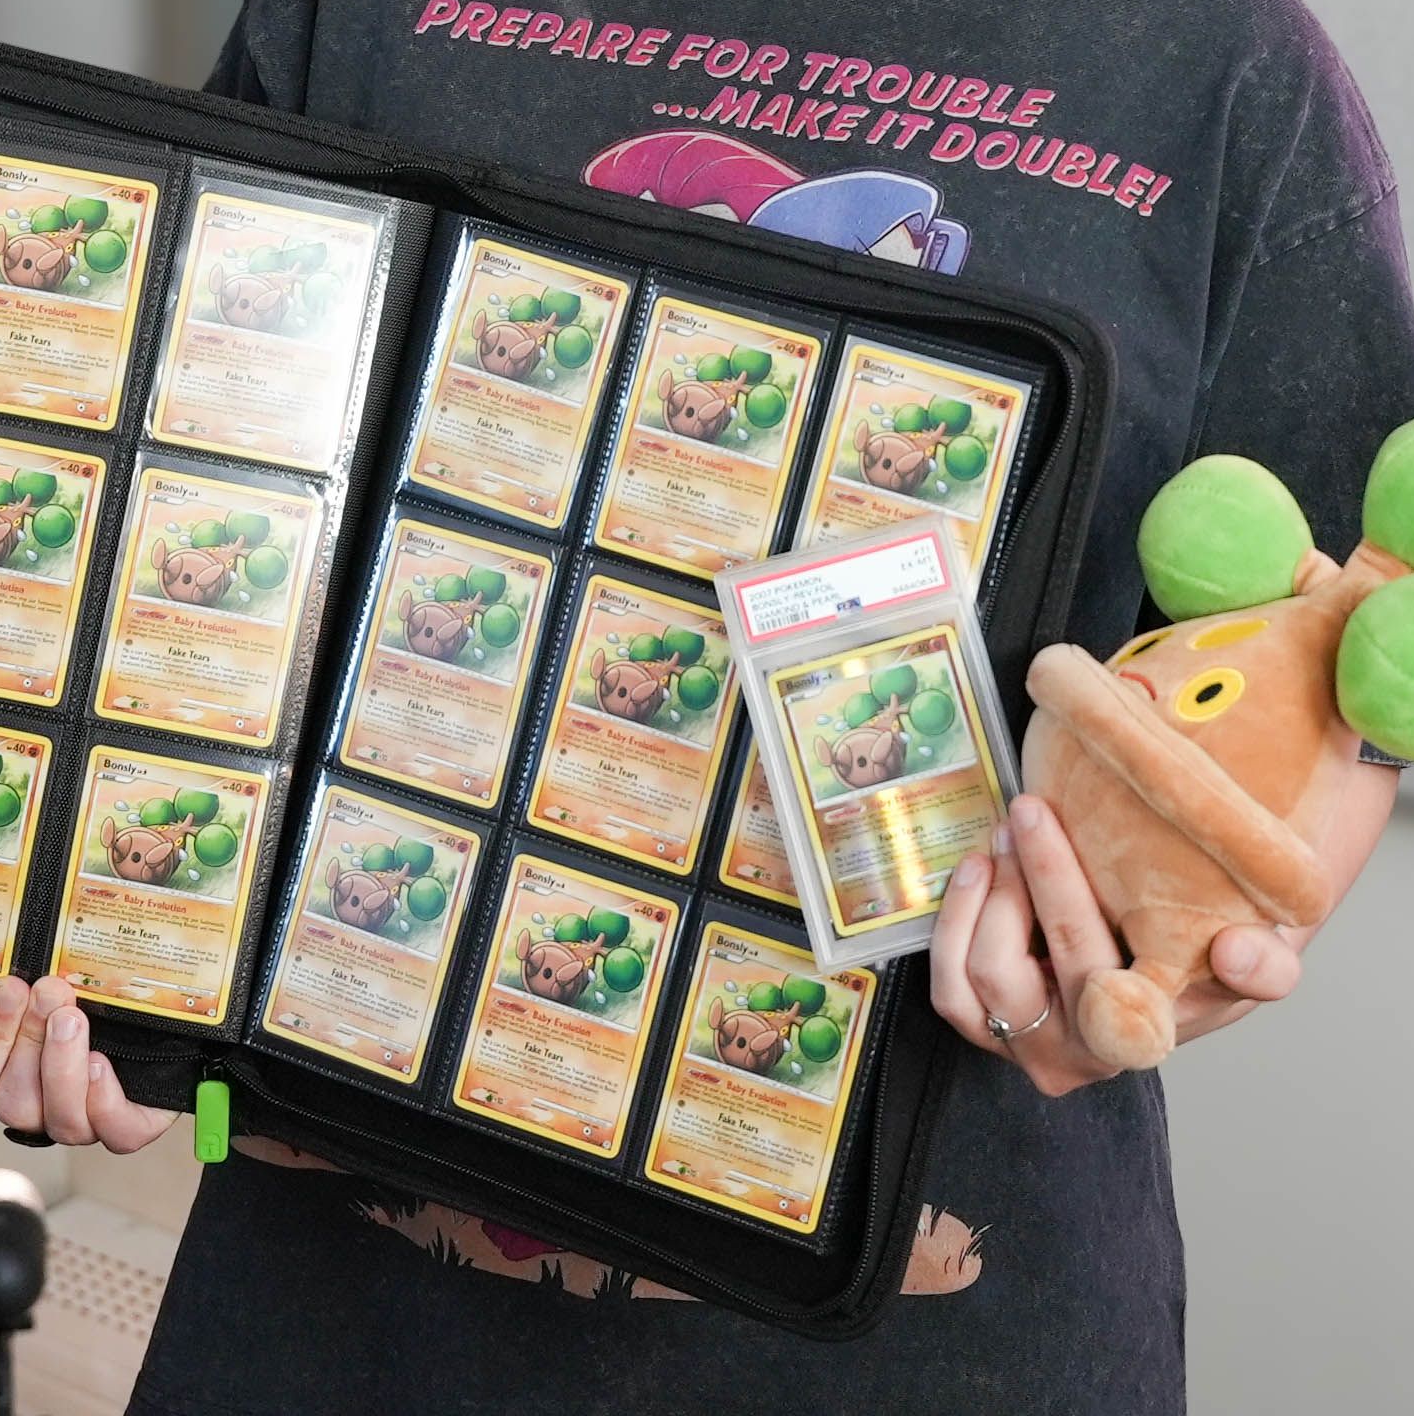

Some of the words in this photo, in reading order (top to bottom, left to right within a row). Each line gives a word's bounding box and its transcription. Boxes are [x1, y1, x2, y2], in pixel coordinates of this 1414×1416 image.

[667, 33, 790, 86] FOR
[798, 51, 1056, 128] TROUBLE
[652, 86, 871, 142] ...MAKE
[865, 110, 935, 151] IT
[929, 122, 1174, 217] DOUBLE!
[118, 191, 131, 200] 40
[483, 252, 512, 270] Bonsly
[590, 287, 603, 297] 40
[15, 301, 36, 313] Baby
[38, 305, 78, 319] Evolution
[9, 332, 28, 342] Fake
[30, 335, 52, 347] Tears
[667, 309, 698, 328] Bonsly
[783, 344, 796, 354] 40
[862, 359, 895, 378] Bonsly
[485, 387, 504, 402] Baby
[505, 394, 541, 412] Evolution
[476, 418, 493, 430] Fake
[495, 423, 514, 437] Tears
[66, 465, 80, 474] 40
[674, 449, 695, 464] Baby
[696, 455, 734, 473] Evolution
[155, 480, 189, 497] Bonsly
[666, 480, 684, 493] Fake
[686, 486, 706, 500] Tears
[871, 501, 892, 516] Baby
[406, 532, 436, 550] Bonsly
[516, 565, 528, 574] 40
[599, 589, 631, 608] Bonsly
[174, 616, 195, 629] Baby
[197, 620, 238, 635] Evolution
[167, 647, 187, 658] Fake
[189, 651, 211, 663] Tears
[414, 669, 434, 683] Baby
[435, 675, 472, 692] Evolution
[407, 700, 424, 712] Fake
[426, 705, 446, 719] Tears
[12, 745, 26, 754] 40
[606, 729, 627, 744] Baby
[628, 736, 667, 755] Evolution
[103, 759, 137, 775] Bonsly
[229, 784, 242, 793] 40
[598, 760, 616, 774] Fake
[618, 767, 639, 781] Tears
[336, 799, 365, 818] Bonsly
[444, 839, 456, 849] 40
[525, 868, 556, 888] Bonsly
[640, 908, 653, 918] 40
[123, 894, 145, 907] Baby
[147, 899, 188, 914] Evolution
[117, 925, 137, 936] Fake
[139, 929, 161, 941] Tears
[339, 937, 359, 953] Baby
[359, 945, 396, 964] Evolution
[717, 936, 749, 956] Bonsly
[836, 976, 850, 986] 40
[330, 968, 348, 982] Fake
[349, 975, 369, 990] Tears
[532, 1010, 552, 1026] Baby
[553, 1018, 592, 1037] Evolution
[523, 1042, 542, 1055] Fake
[543, 1048, 564, 1063] Tears
[726, 1081, 747, 1096] Baby
[748, 1088, 788, 1108] Evolution
[717, 1113, 736, 1127] Fake
[738, 1120, 759, 1135] Tears
